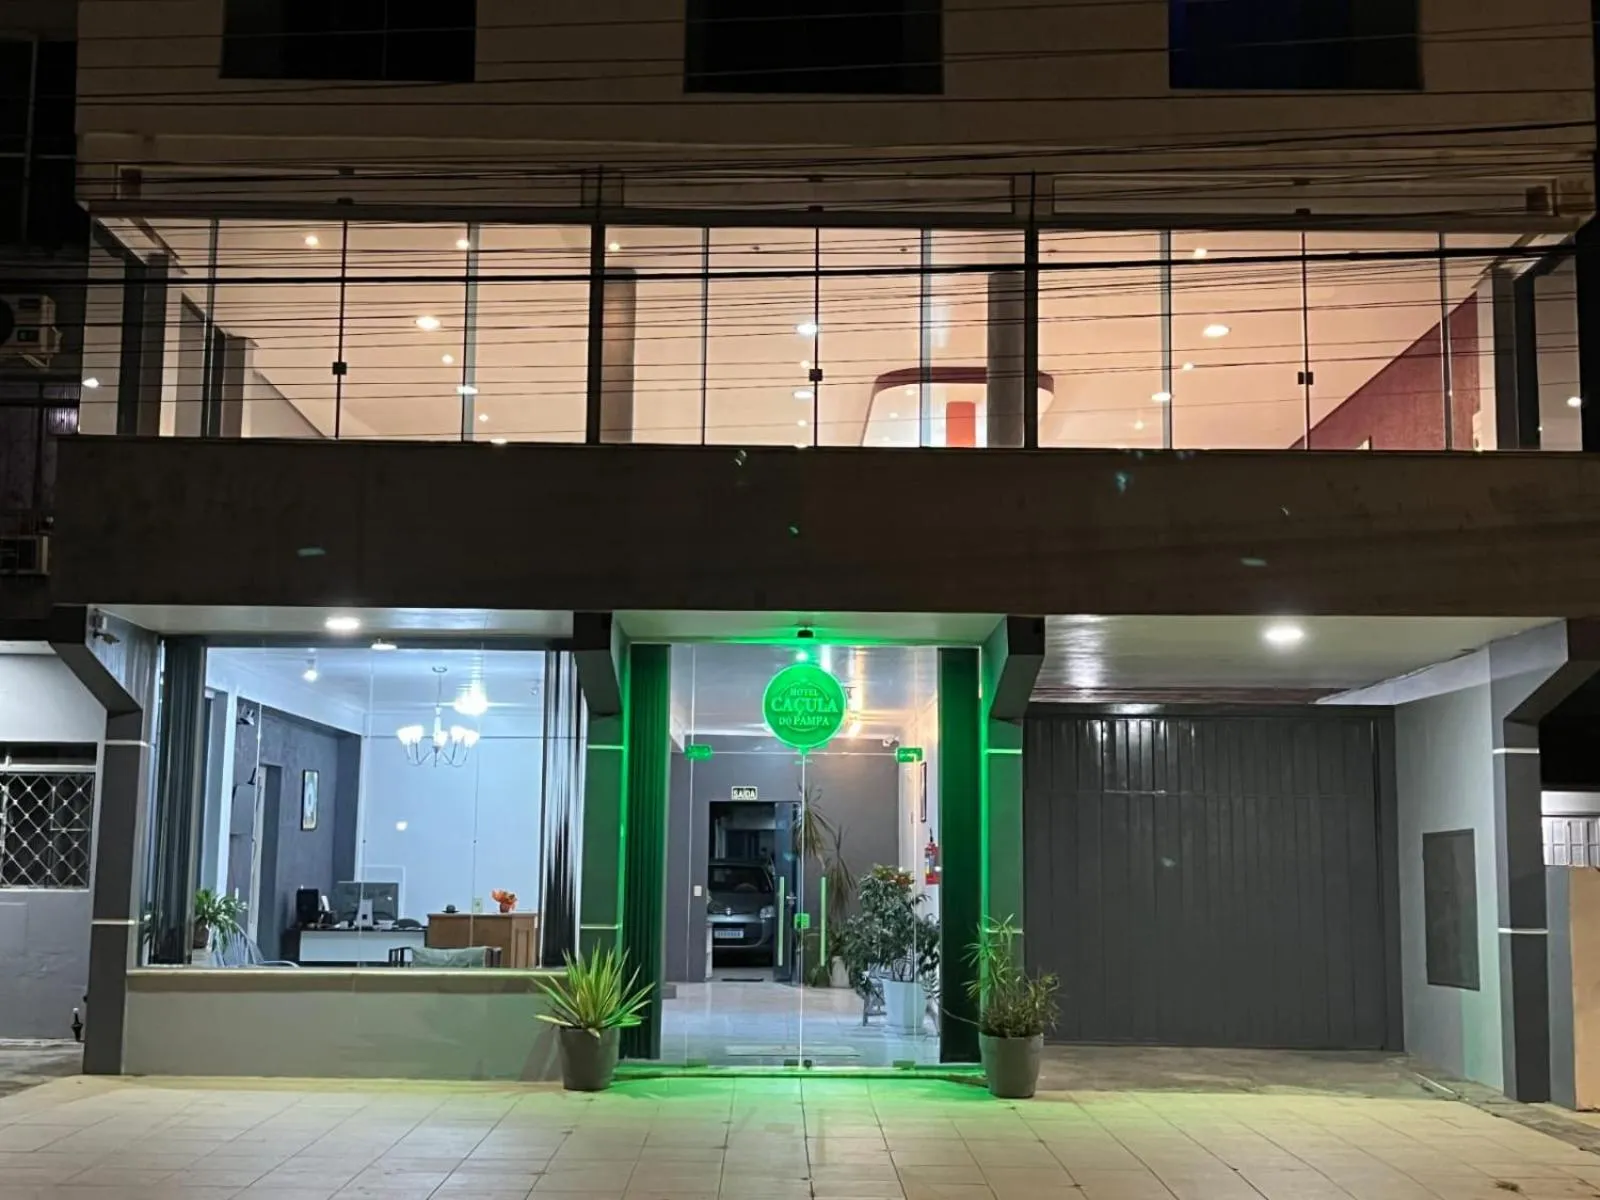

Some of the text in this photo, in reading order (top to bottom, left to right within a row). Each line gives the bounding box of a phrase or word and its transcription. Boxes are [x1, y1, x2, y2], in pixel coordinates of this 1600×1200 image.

[790, 688, 818, 696] HOTEL
[779, 715, 830, 726] DO PAMPA
